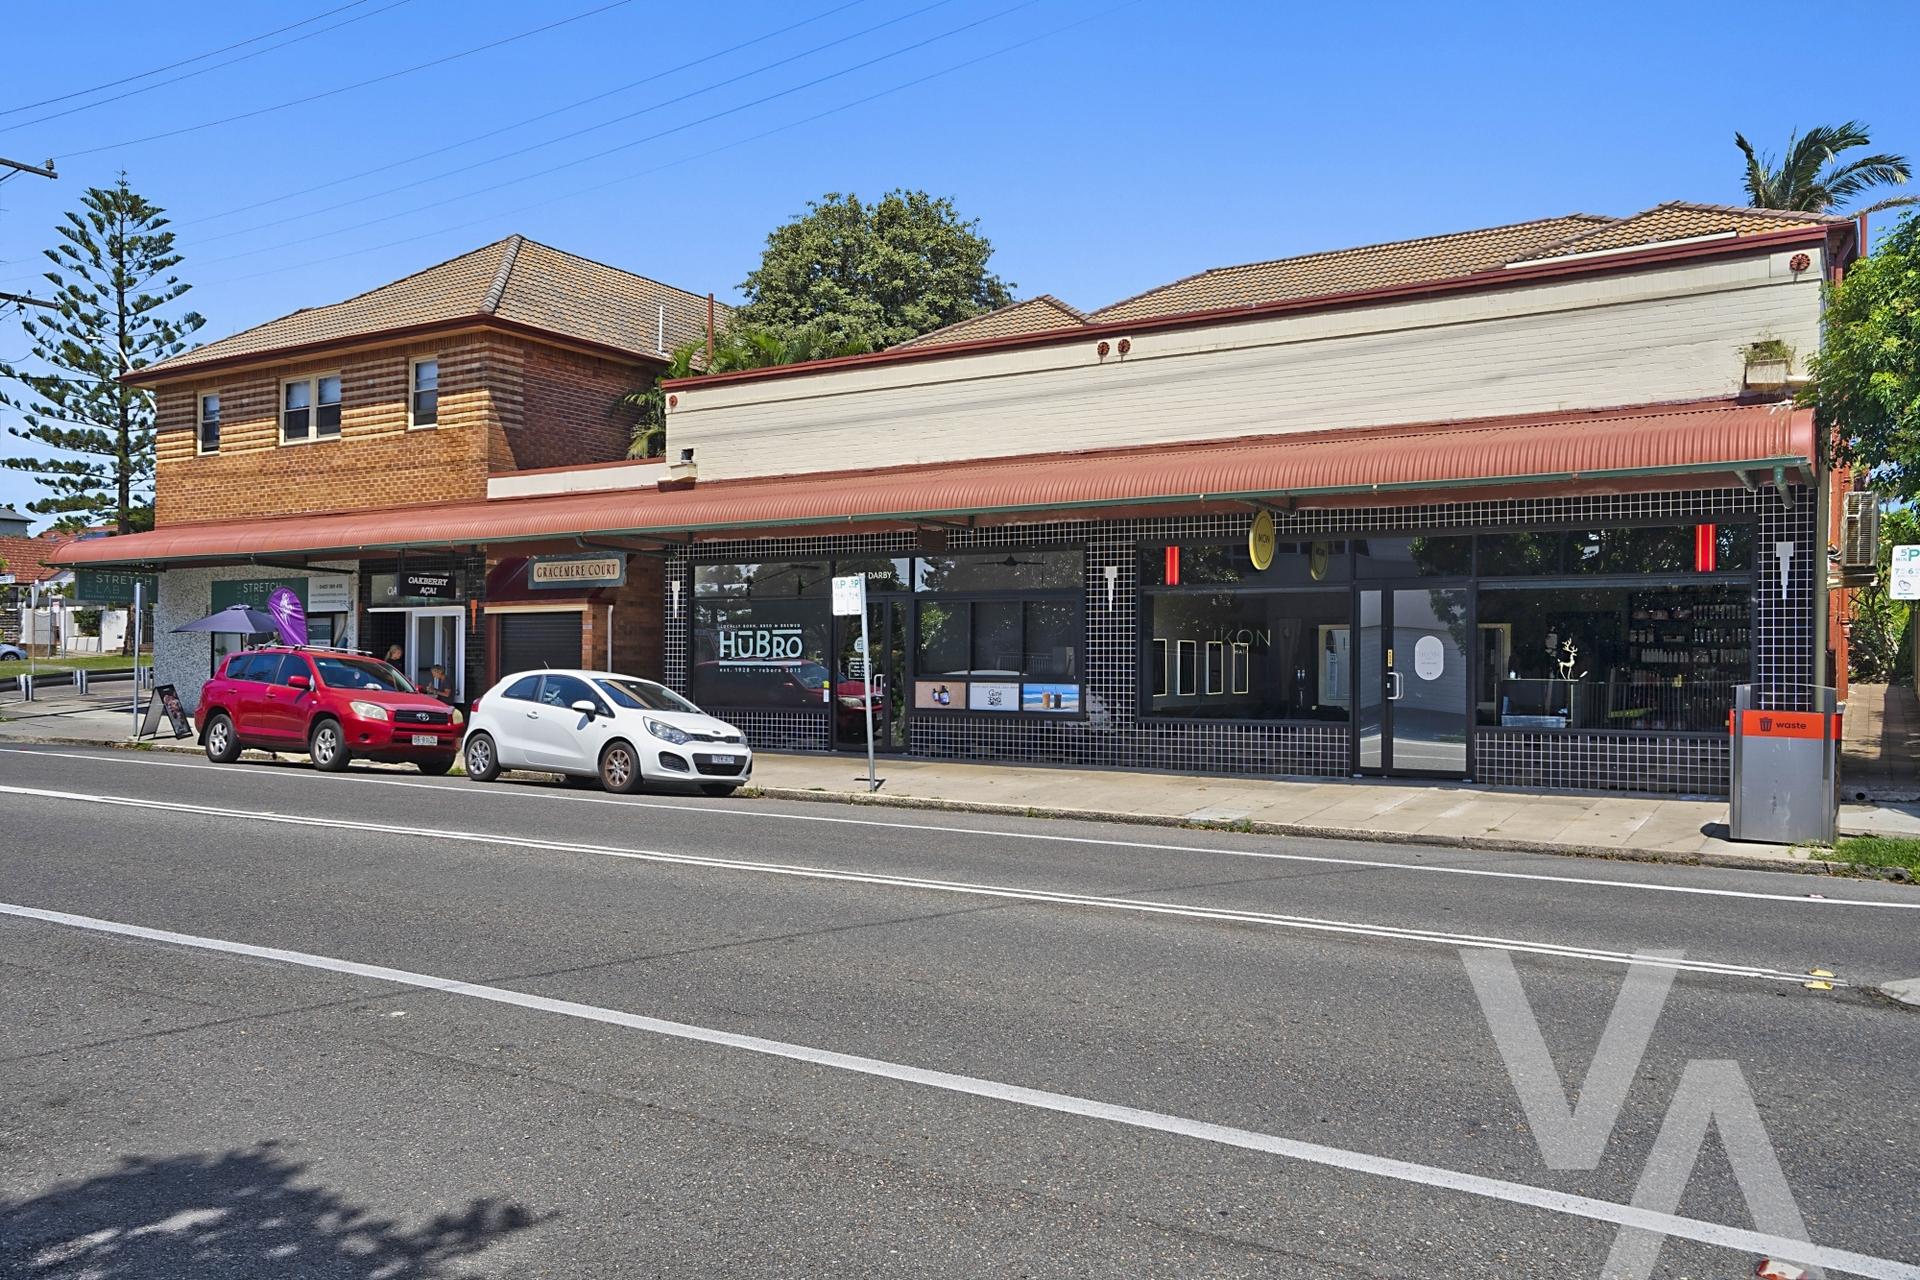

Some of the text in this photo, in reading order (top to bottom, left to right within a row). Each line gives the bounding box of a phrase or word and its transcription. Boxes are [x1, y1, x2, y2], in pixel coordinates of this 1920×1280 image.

[536, 564, 617, 578] GRACEMERE COURT
[868, 571, 893, 580] DARBY
[96, 574, 153, 586] STRETCH
[408, 576, 448, 586] OAKBERRY
[1213, 629, 1271, 647] IKON
[1776, 722, 1807, 730] waste
